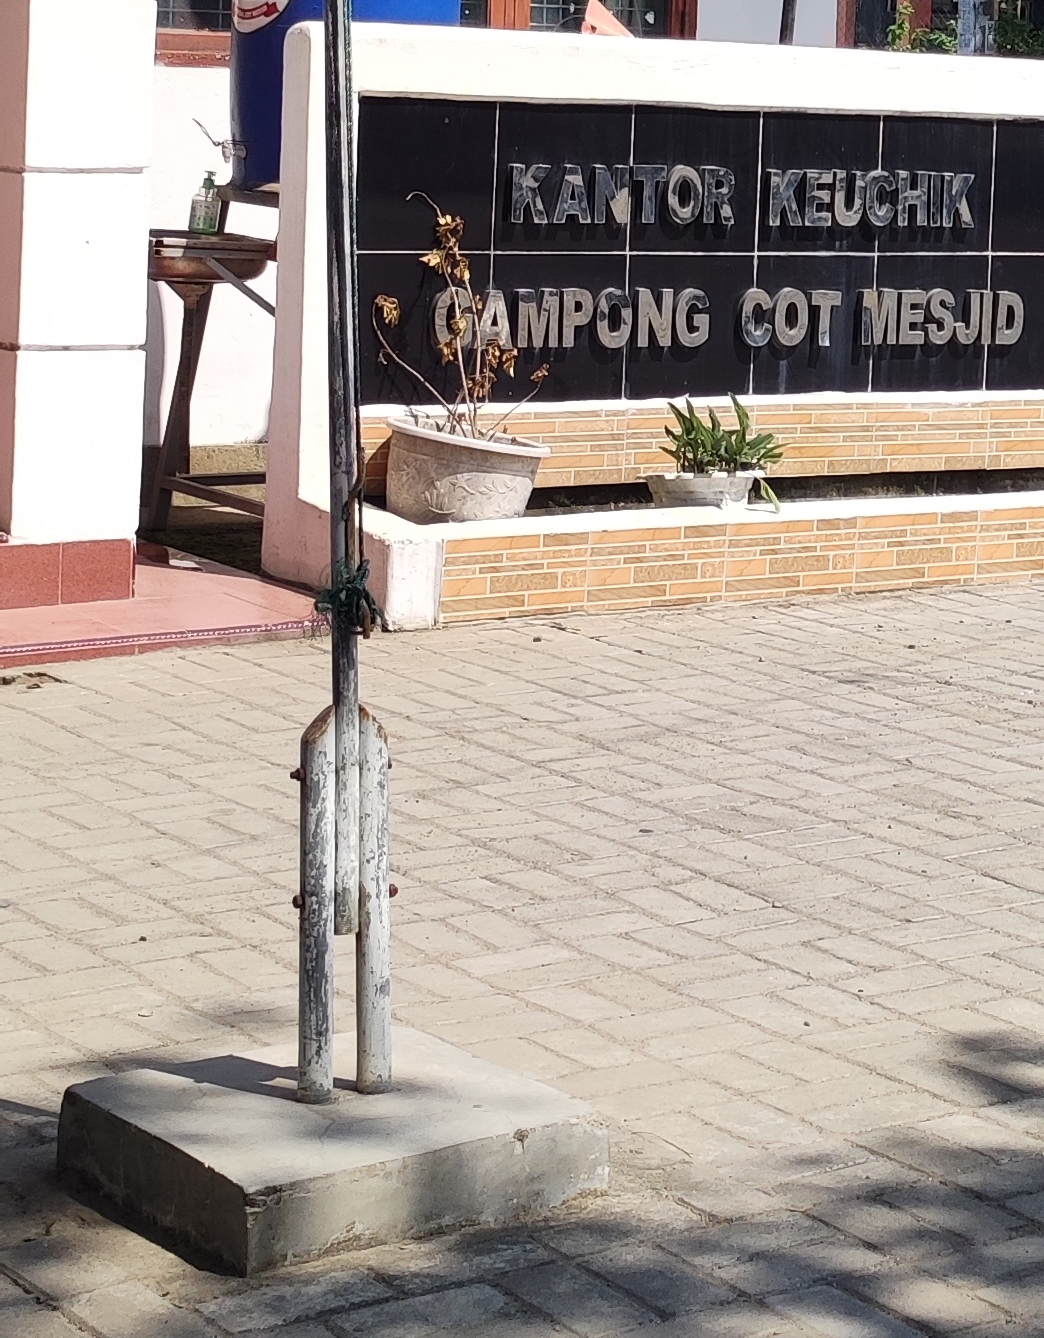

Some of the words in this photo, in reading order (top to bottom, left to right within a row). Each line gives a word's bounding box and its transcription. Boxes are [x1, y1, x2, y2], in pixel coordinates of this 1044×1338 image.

[508, 162, 737, 228] KANTOR
[765, 168, 977, 231] KEUCHIK
[432, 286, 711, 351] GAMPONG
[739, 287, 843, 349] COT
[860, 287, 1026, 347] MESJID
